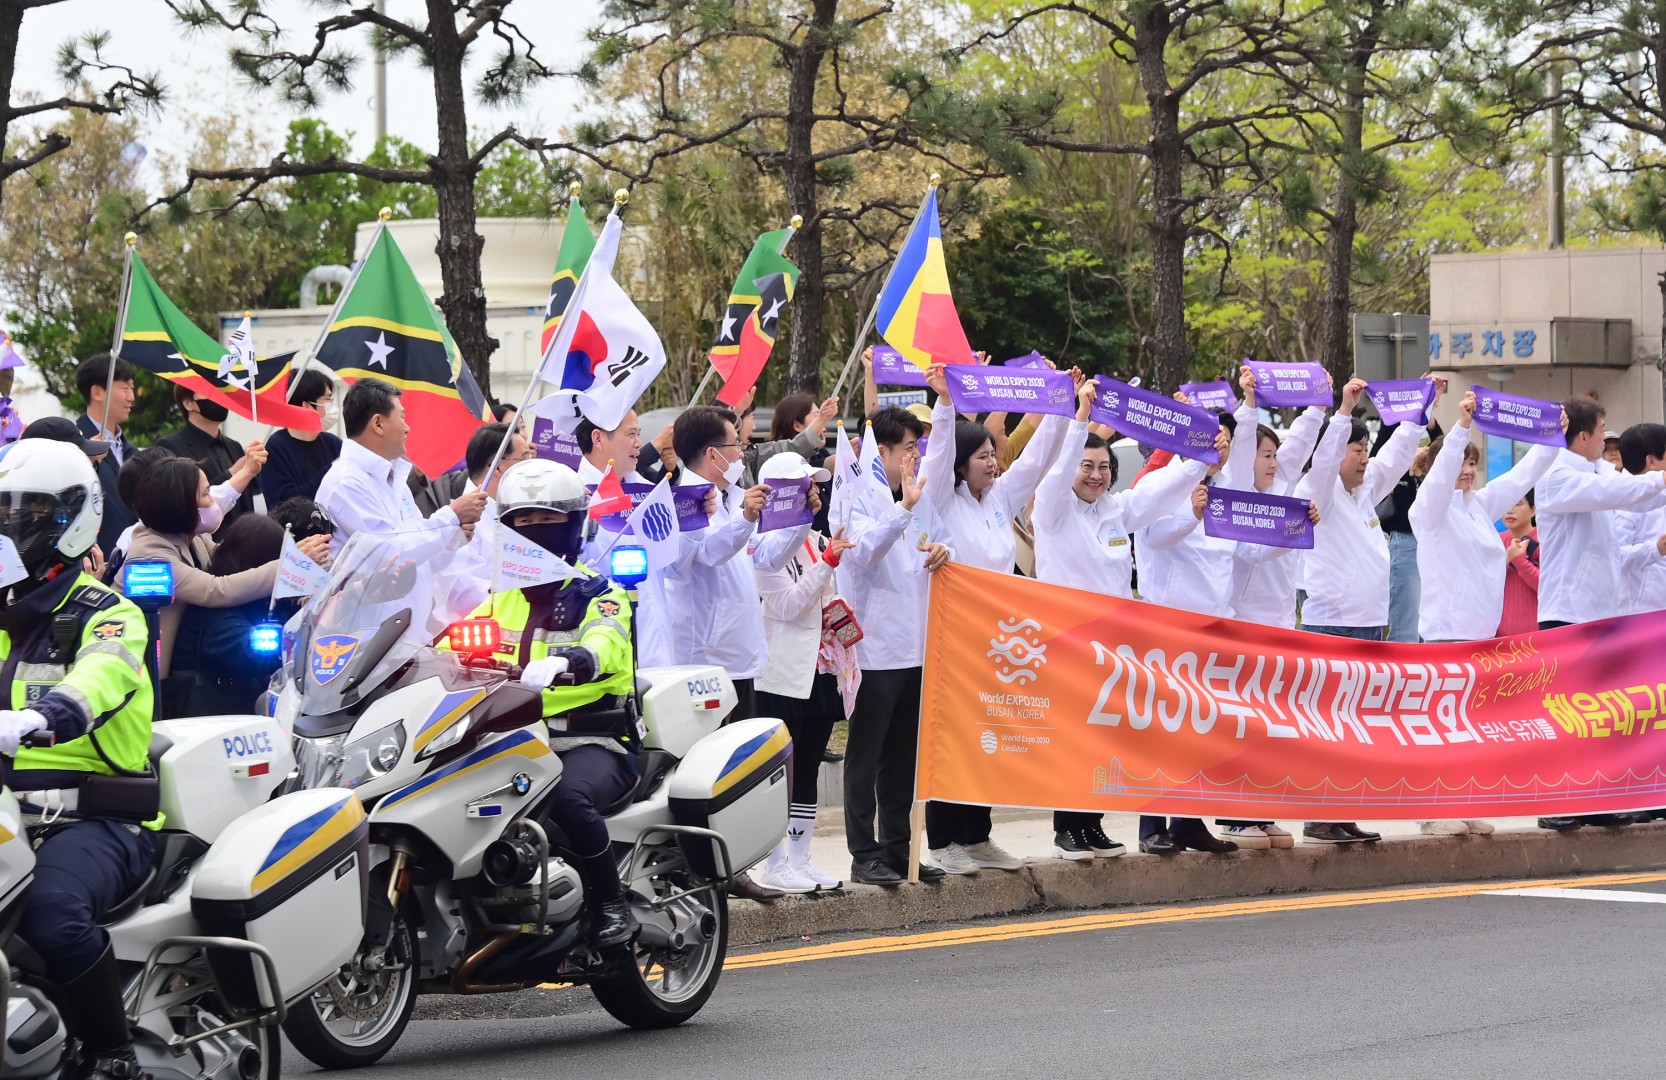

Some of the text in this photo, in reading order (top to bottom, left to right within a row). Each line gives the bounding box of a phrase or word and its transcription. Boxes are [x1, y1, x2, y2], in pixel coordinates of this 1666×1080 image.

[984, 375, 1046, 388] WORLD EXPO 2030
[989, 388, 1016, 400] BUSAN,
[1015, 389, 1038, 400] KOREA
[1128, 397, 1154, 415] WORLD
[1153, 405, 1172, 421] EXPO
[1171, 411, 1192, 427] 2030
[1498, 400, 1542, 419] WORLD EXPO 2030
[1126, 411, 1152, 431] BUSAN,
[1152, 419, 1176, 436] KOREA
[1516, 417, 1534, 429] KOREA
[1231, 501, 1286, 518] WORLD EXPO 2030
[1232, 514, 1256, 528] BUSAN,
[1254, 517, 1276, 529] KOREA
[1471, 636, 1540, 672] BUSAN
[688, 677, 722, 696] POLICE
[1471, 657, 1558, 710] is Ready!
[979, 691, 1050, 708] World EXPO 2030
[986, 705, 1046, 720] BUSAN, KOREA
[1477, 717, 1558, 743] 부산 유치를
[222, 731, 273, 758] POLICE
[1001, 734, 1021, 742] World
[1021, 735, 1036, 744] Expo
[1001, 745, 1028, 753] Candidate
